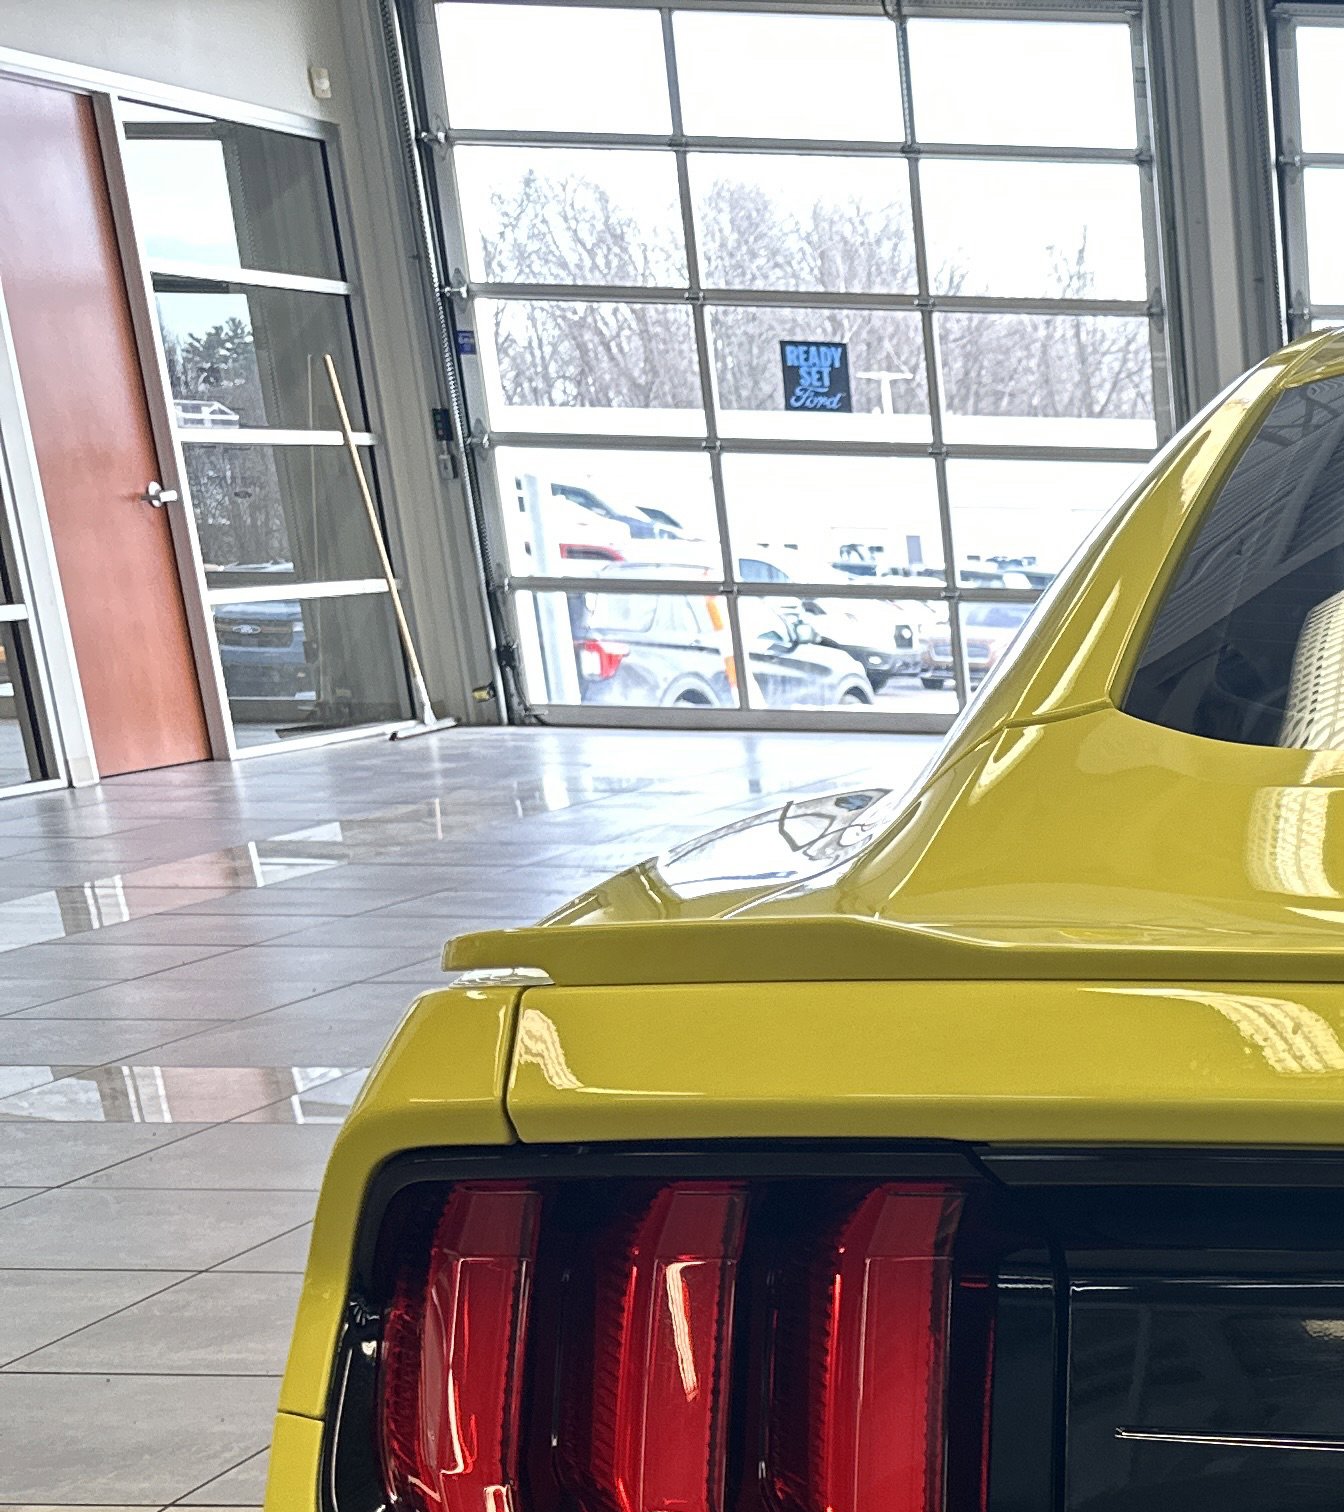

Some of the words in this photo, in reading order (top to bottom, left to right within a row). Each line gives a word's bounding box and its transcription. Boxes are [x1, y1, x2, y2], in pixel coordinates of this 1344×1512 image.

[785, 345, 842, 368] READY
[799, 367, 831, 387] SET
[790, 386, 842, 409] Ford
